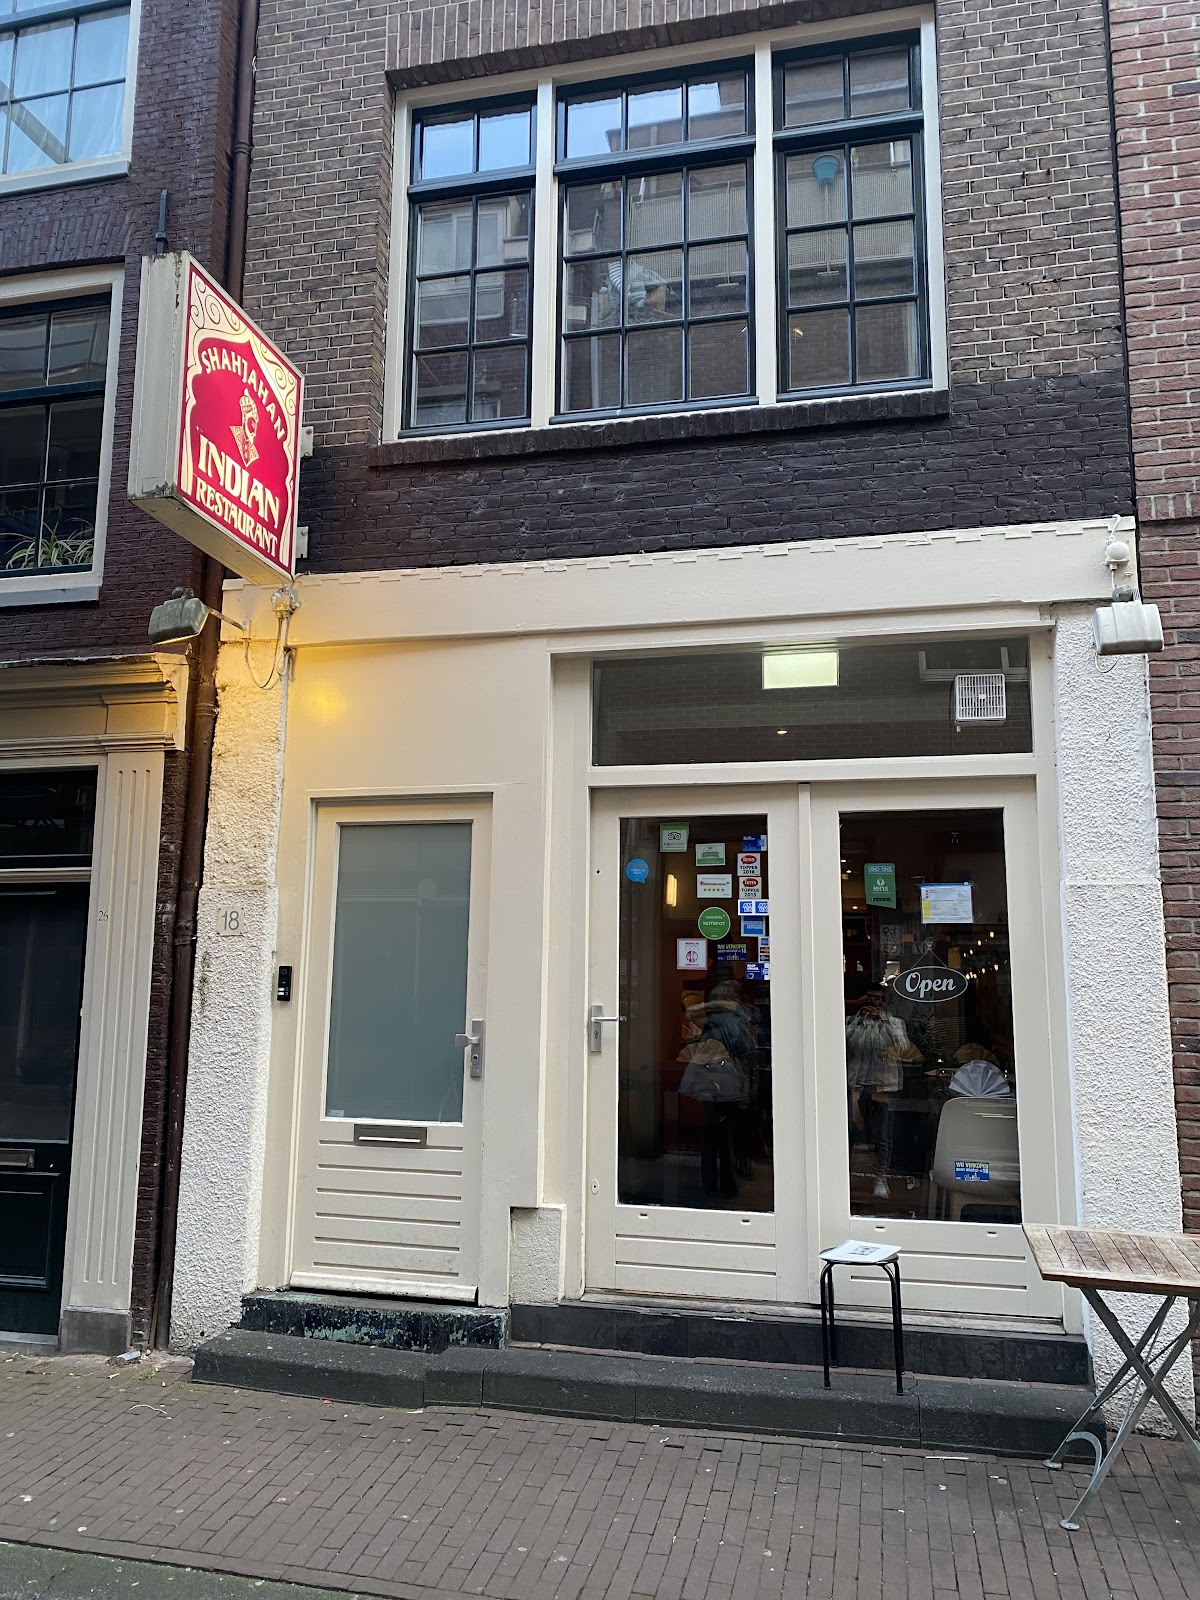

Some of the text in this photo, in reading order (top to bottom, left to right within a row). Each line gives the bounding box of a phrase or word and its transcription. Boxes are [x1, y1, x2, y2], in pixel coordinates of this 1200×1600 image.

[201, 346, 285, 440] SHAHJAHAN
[197, 434, 280, 529] INDIAN
[195, 474, 278, 556] RESTAURANT
[98, 910, 109, 922] 26
[220, 910, 240, 931] 18
[905, 971, 957, 999] Open
